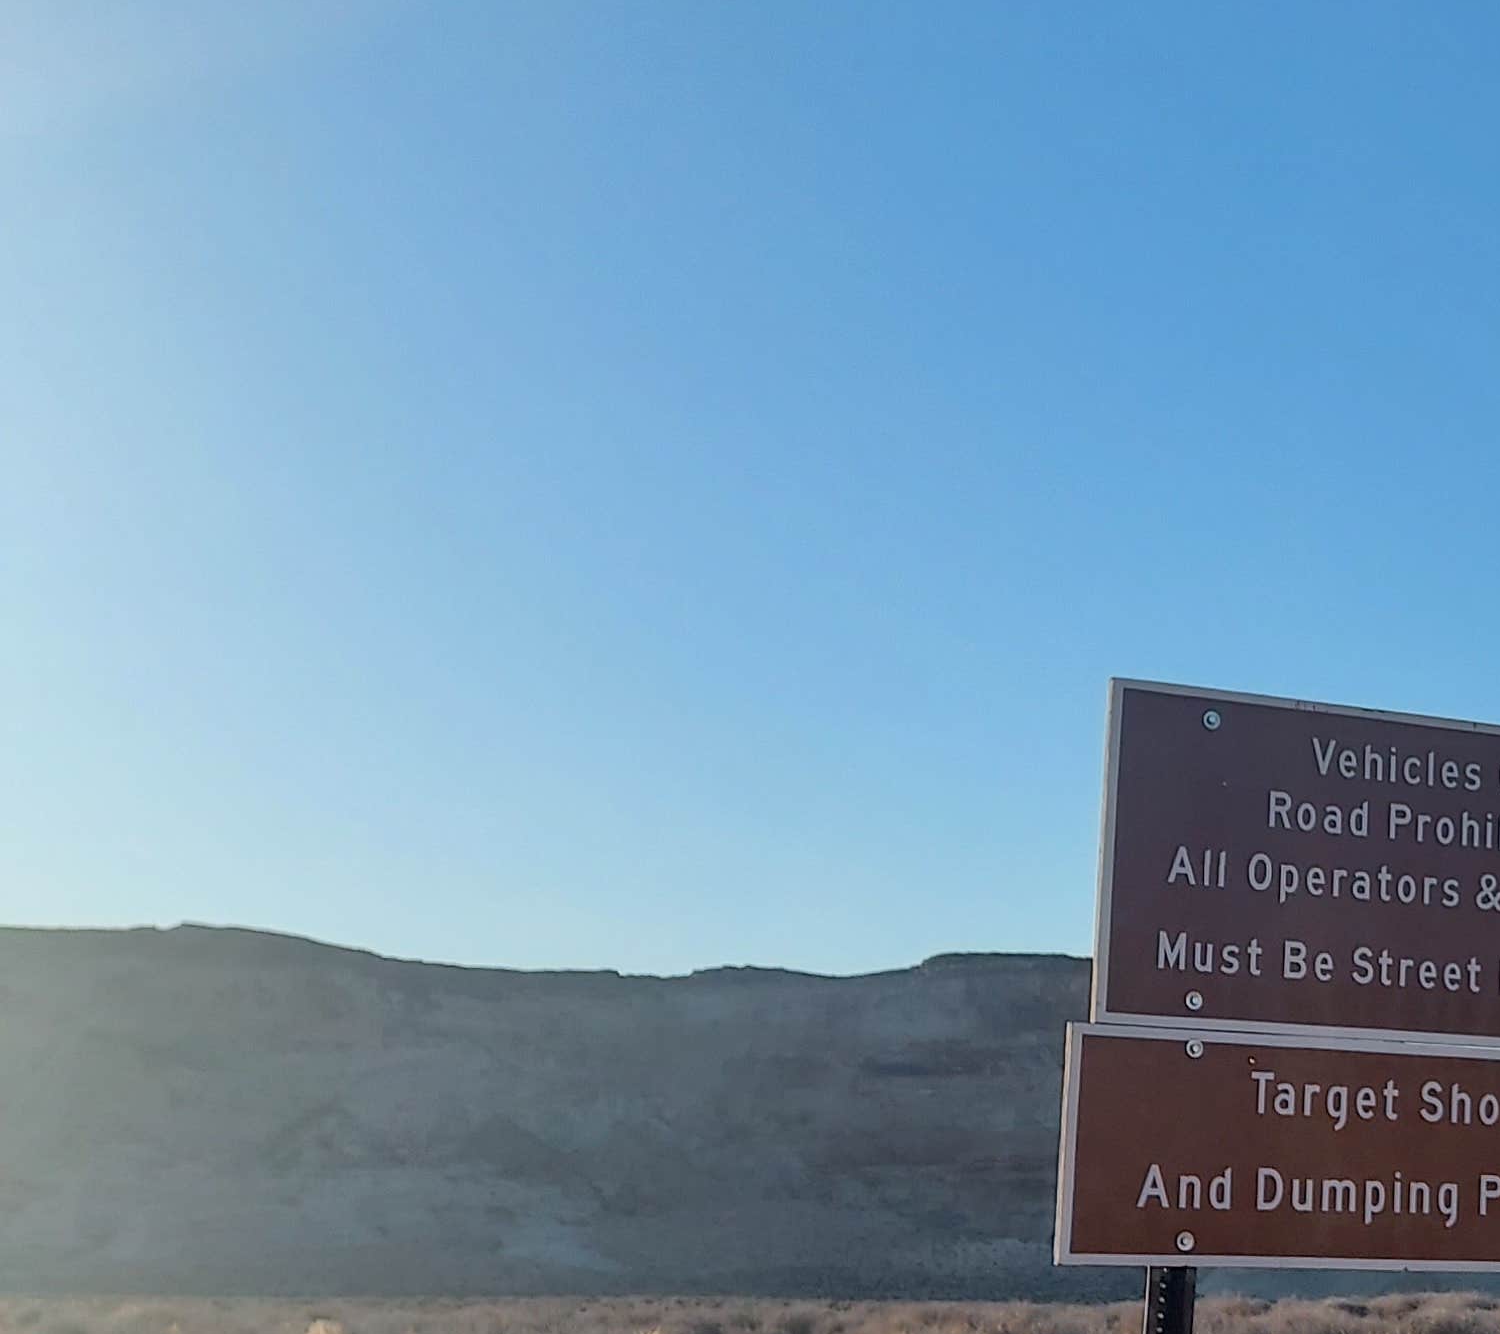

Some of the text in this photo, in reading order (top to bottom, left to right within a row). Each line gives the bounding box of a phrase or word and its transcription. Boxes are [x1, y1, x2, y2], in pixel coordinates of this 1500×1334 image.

[1312, 738, 1481, 790] Vehicles
[1269, 791, 1369, 836] Road
[1167, 846, 1226, 888] All
[1248, 853, 1459, 907] Operators
[1157, 930, 1262, 976] Must
[1283, 940, 1334, 981] Be
[1352, 946, 1481, 992] Street
[1251, 1071, 1399, 1131] Target
[1137, 1164, 1232, 1210] And
[1257, 1167, 1458, 1228] Dumping
